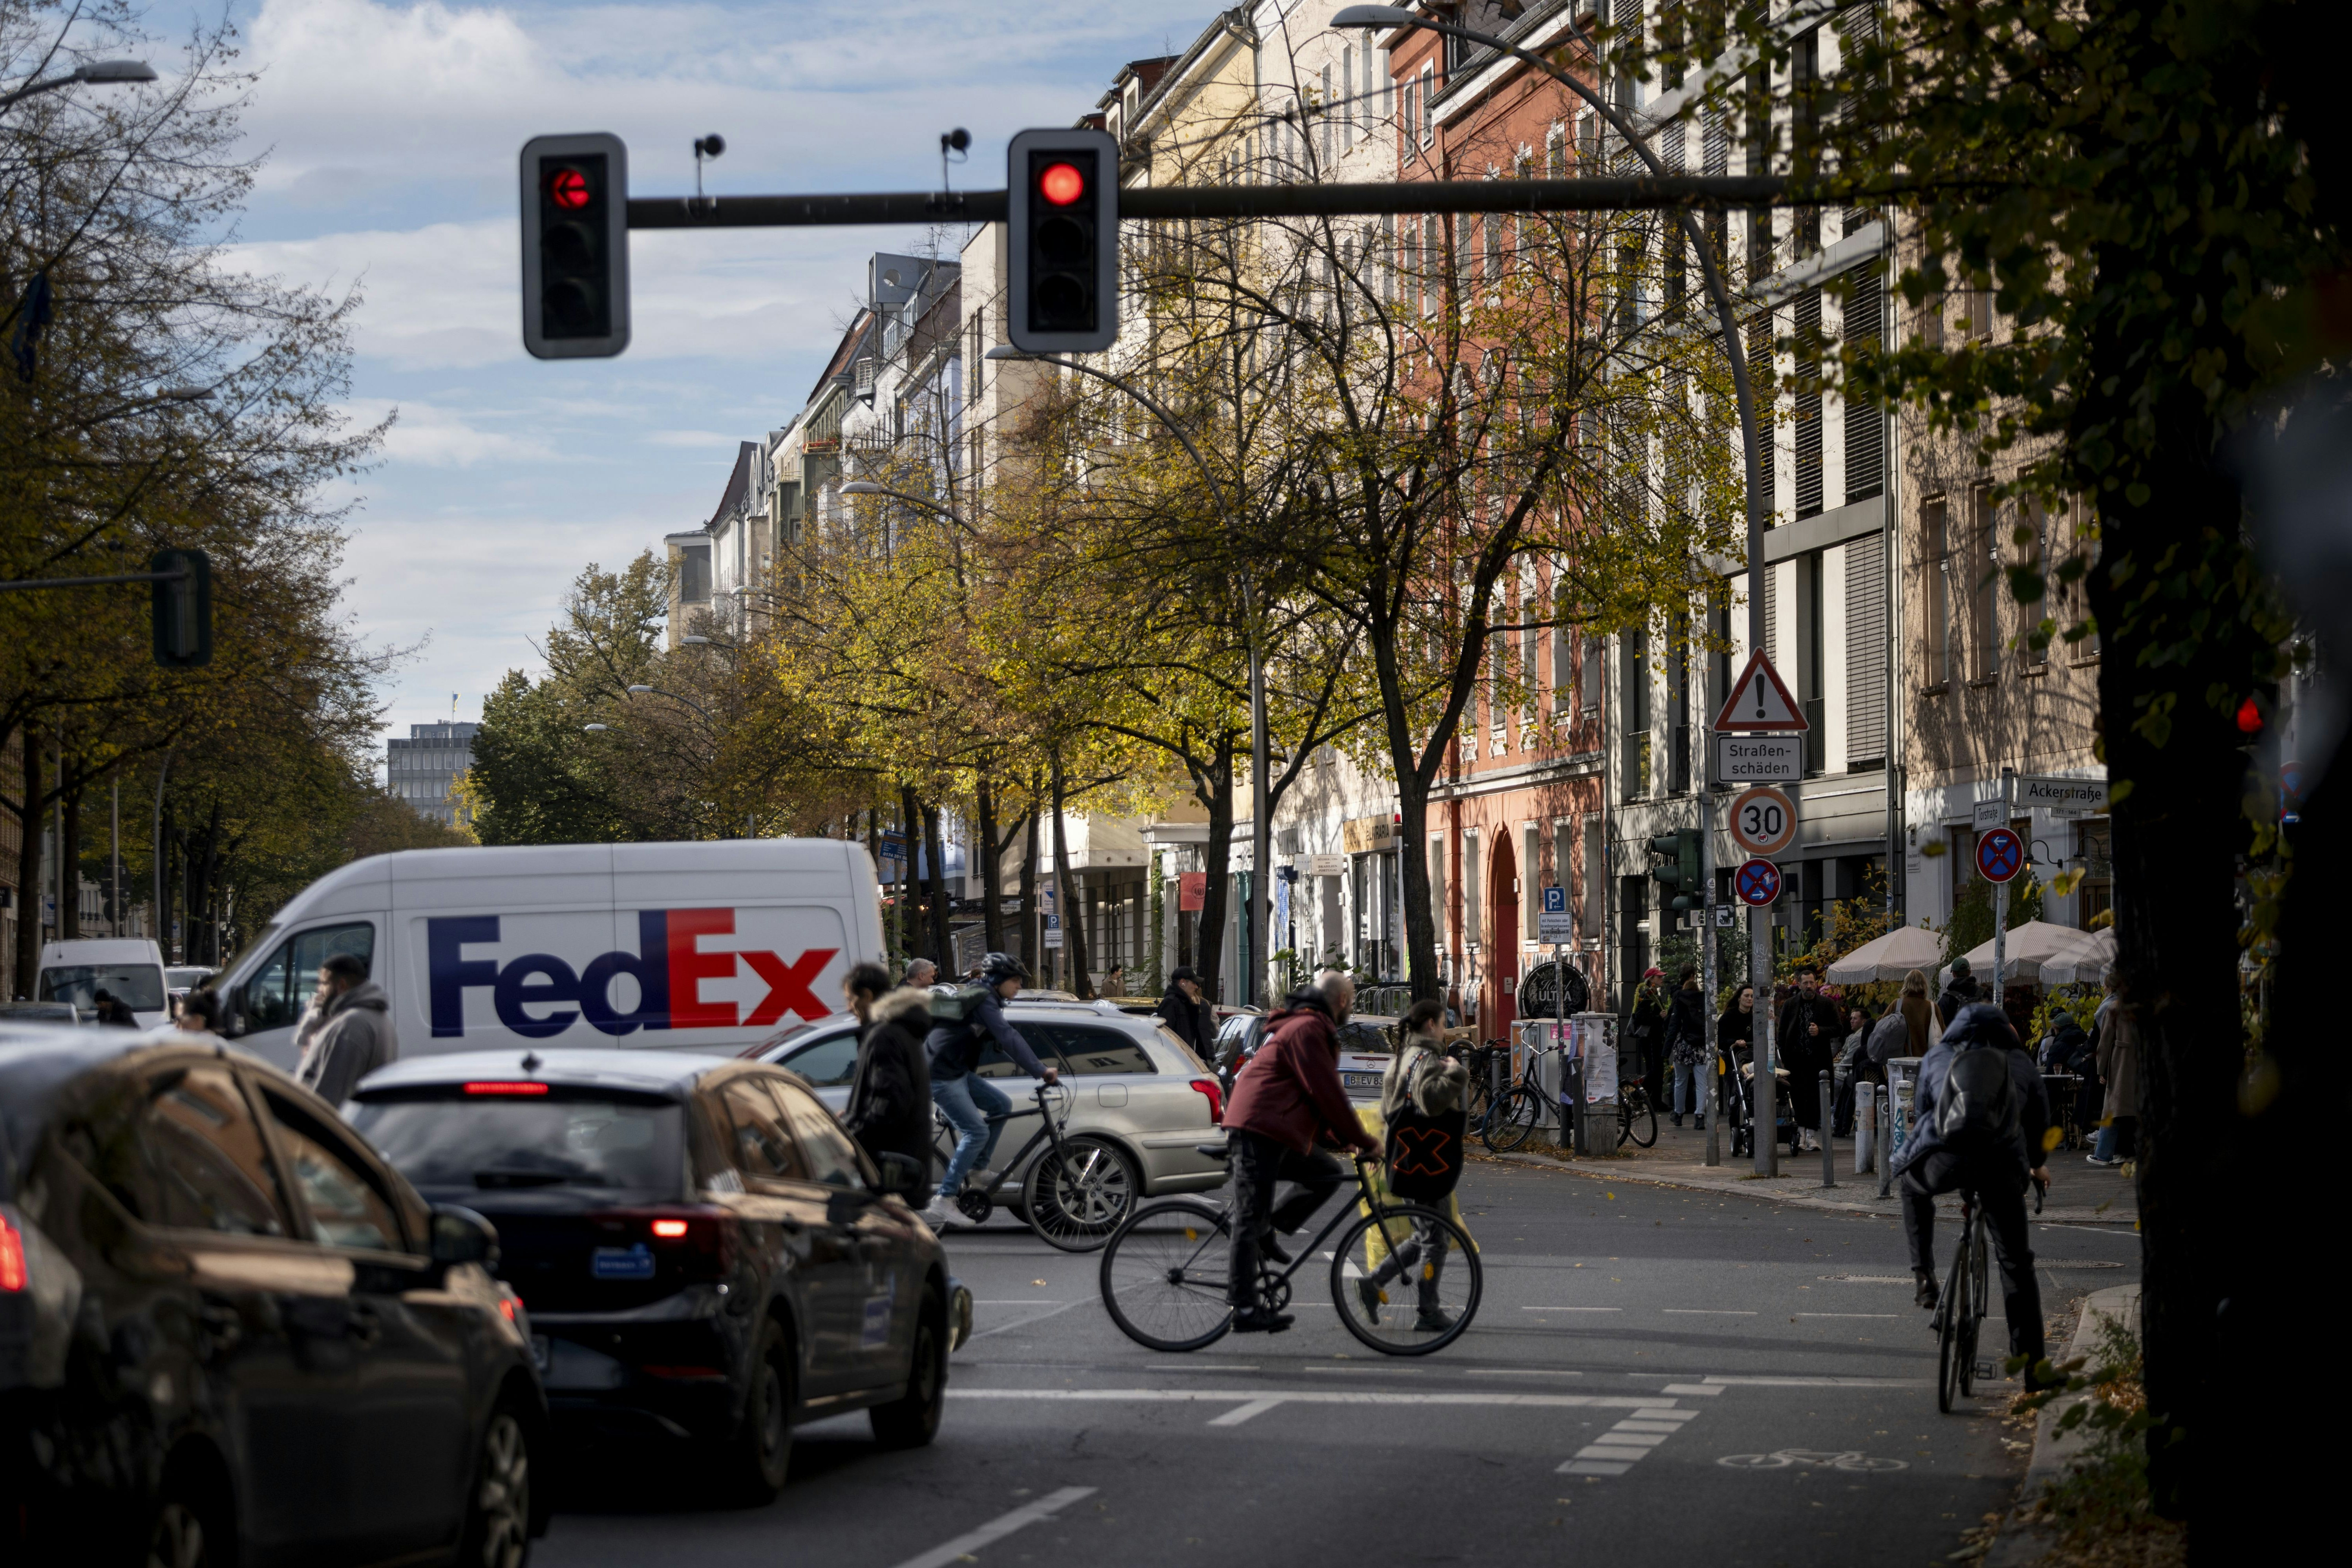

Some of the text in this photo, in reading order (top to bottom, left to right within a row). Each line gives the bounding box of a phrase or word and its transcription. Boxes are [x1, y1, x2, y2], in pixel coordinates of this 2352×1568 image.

[1729, 744, 1791, 757] Straßen-
[1732, 762, 1789, 774] schäden
[2029, 783, 2102, 803] Ackerstraße
[1743, 805, 1782, 835] 30
[1978, 805, 1998, 822] Torstraße
[1548, 890, 1561, 909] P
[427, 908, 841, 1038] FedEx
[1539, 991, 1572, 1001] ULTA
[1351, 1076, 1356, 1084] B
[1361, 1076, 1372, 1085] EV
